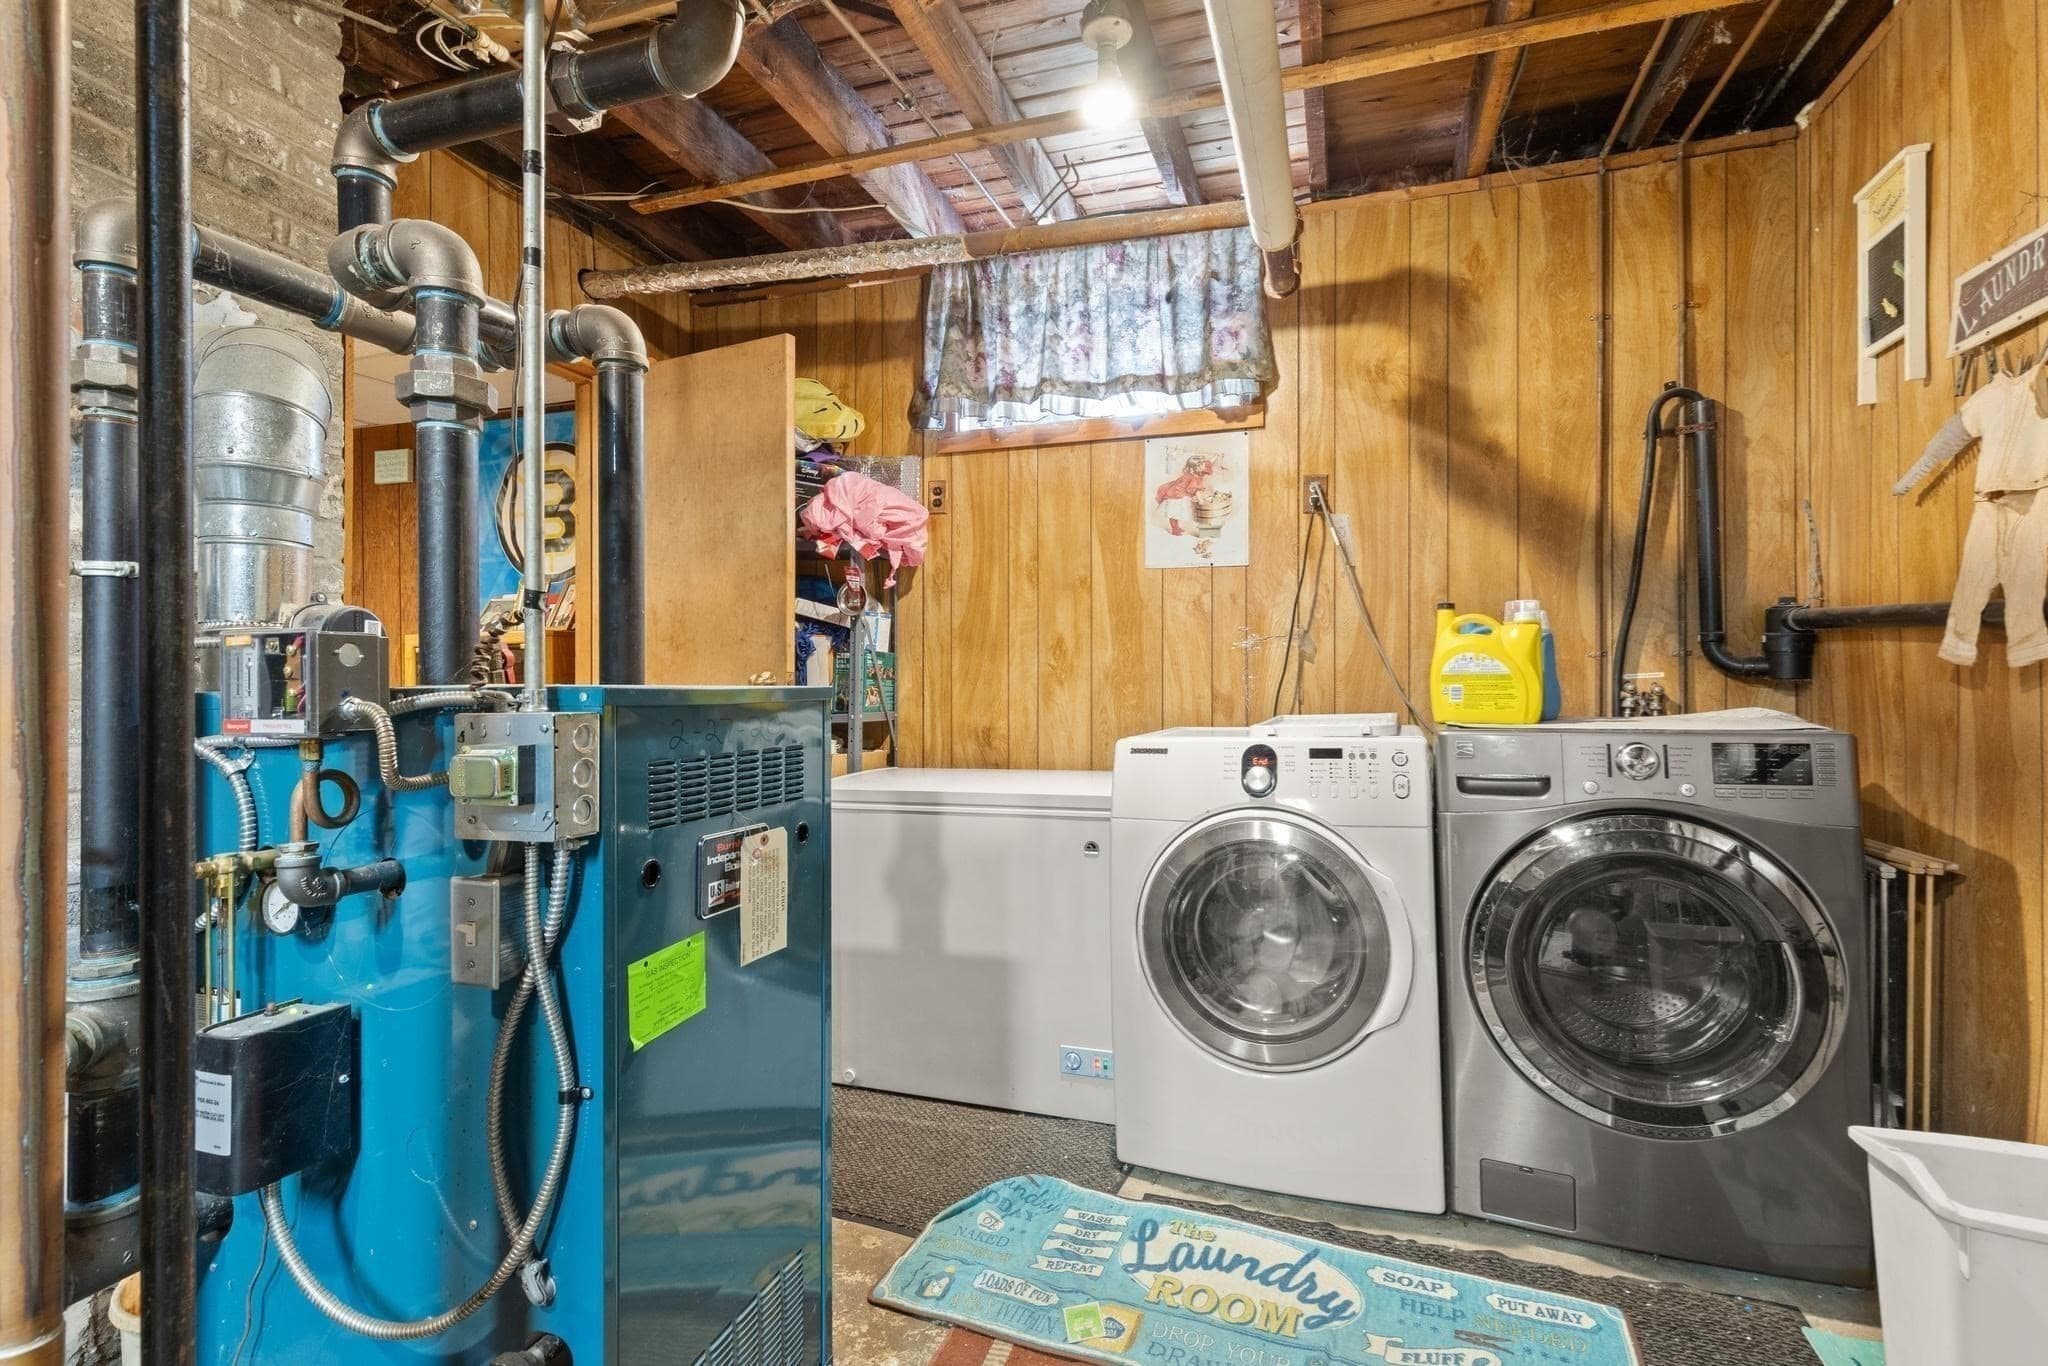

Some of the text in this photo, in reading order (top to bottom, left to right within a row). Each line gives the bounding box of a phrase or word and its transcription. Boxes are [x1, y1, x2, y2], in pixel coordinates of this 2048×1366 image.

[1077, 1212, 1113, 1224] WASH
[952, 1225, 1011, 1248] NAKED
[1074, 1228, 1101, 1239] DRY
[1169, 1219, 1217, 1242] The
[1060, 1241, 1094, 1255] FOLD
[1046, 1260, 1097, 1274] REPEAT
[1122, 1218, 1358, 1330] Laundry
[979, 1272, 1053, 1304] LOADS OF FUN
[1382, 1271, 1445, 1294] SOAP
[1145, 1274, 1304, 1339] ROOM
[1401, 1299, 1466, 1323] HELP
[1498, 1297, 1583, 1325] PUT AWAY
[1151, 1319, 1215, 1351] DROP
[1401, 1352, 1466, 1366] FLUFF
